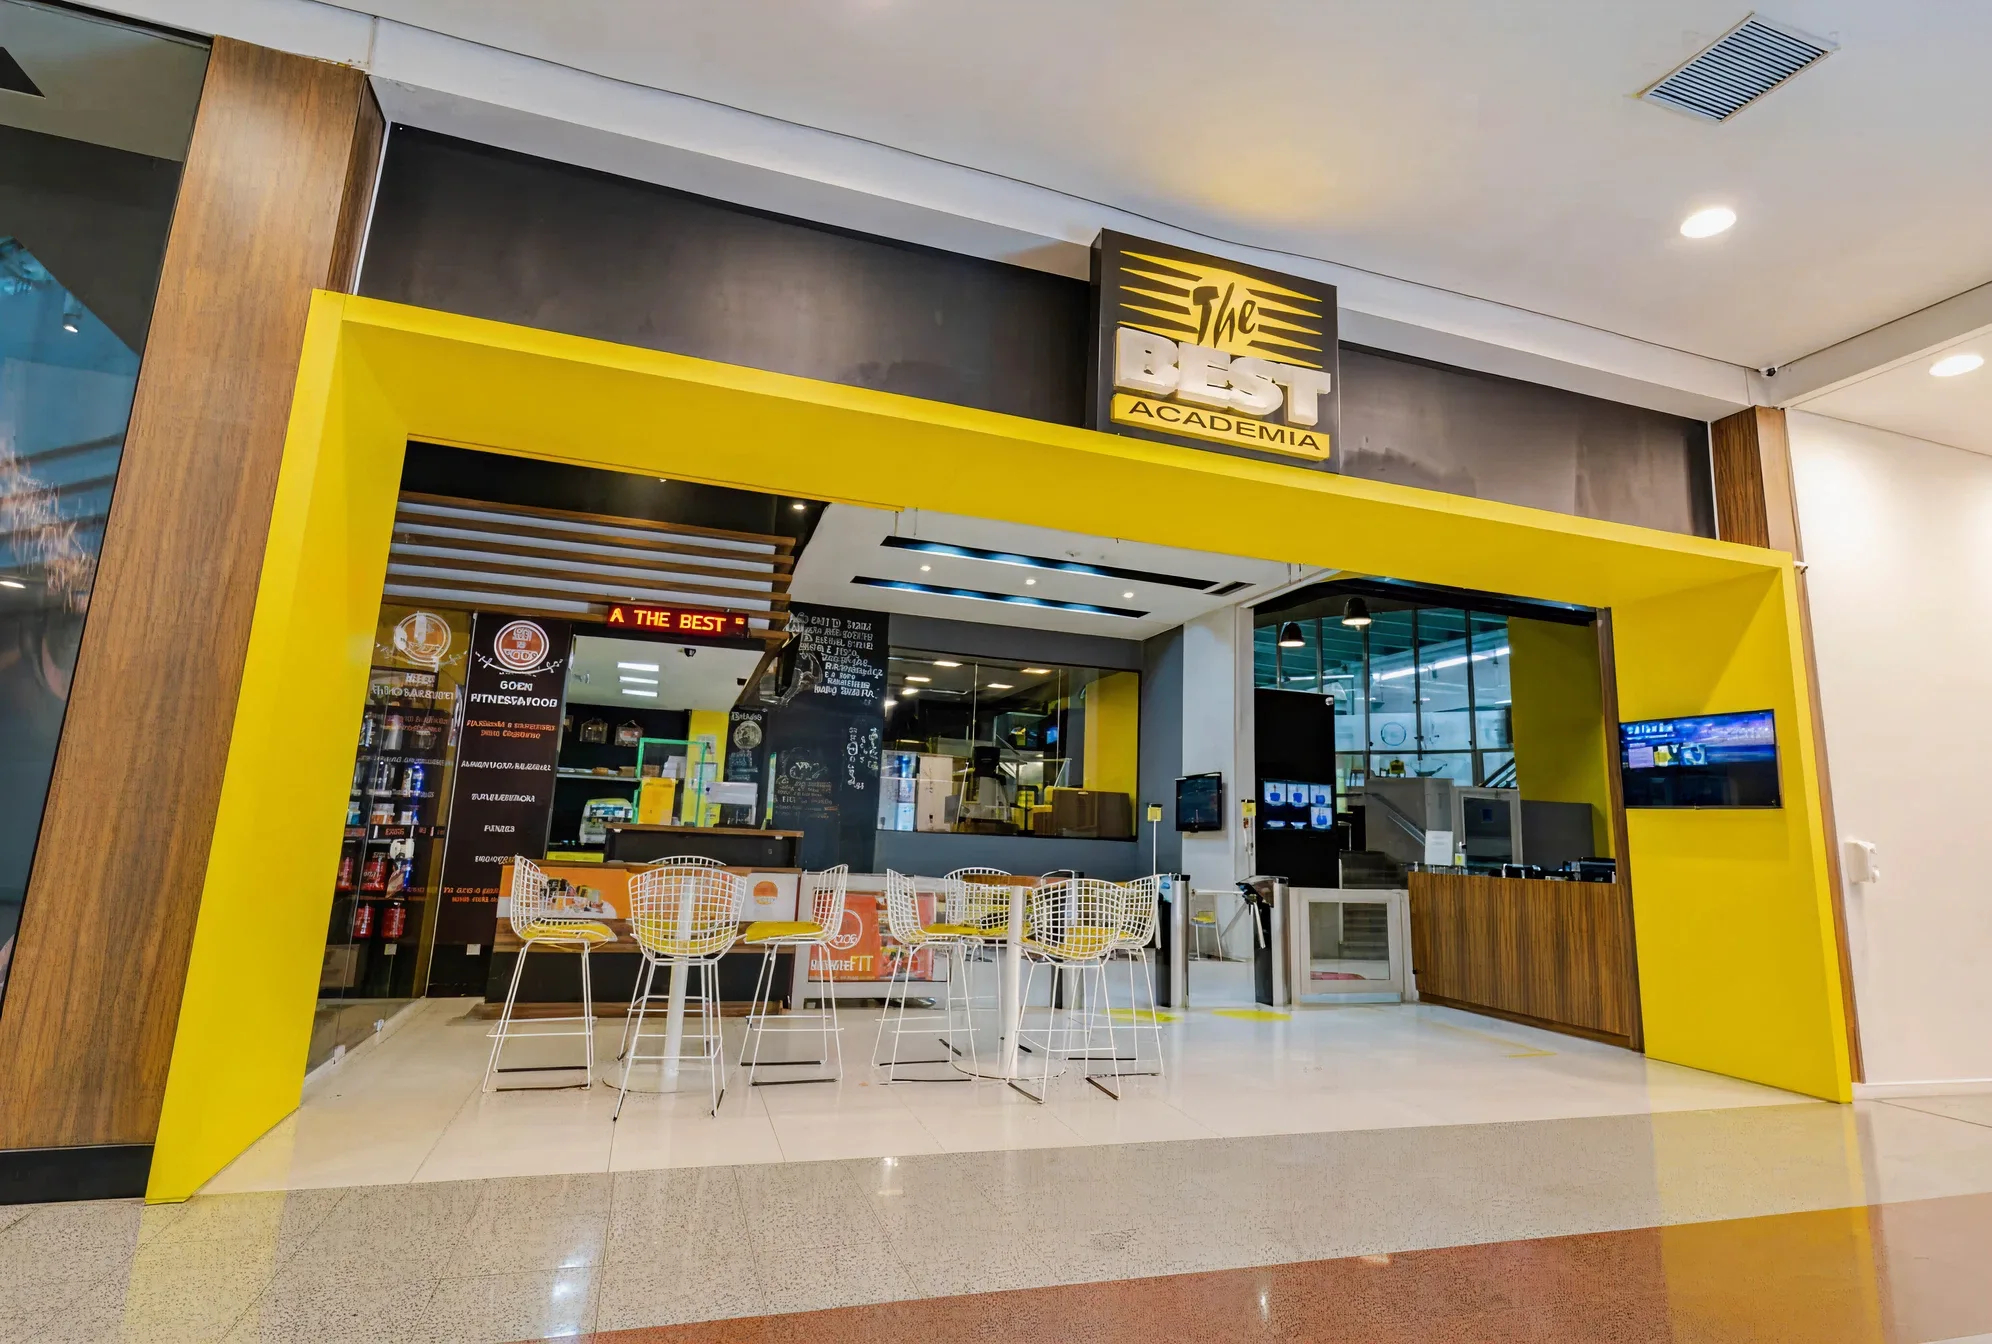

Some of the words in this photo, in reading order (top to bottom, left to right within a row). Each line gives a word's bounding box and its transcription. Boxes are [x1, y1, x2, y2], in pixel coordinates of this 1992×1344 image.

[1192, 282, 1257, 348] The
[1113, 326, 1331, 428] BEST
[1128, 400, 1321, 451] ACADEMIA
[609, 607, 625, 623] A
[633, 609, 671, 628] THE
[679, 614, 727, 632] BEST
